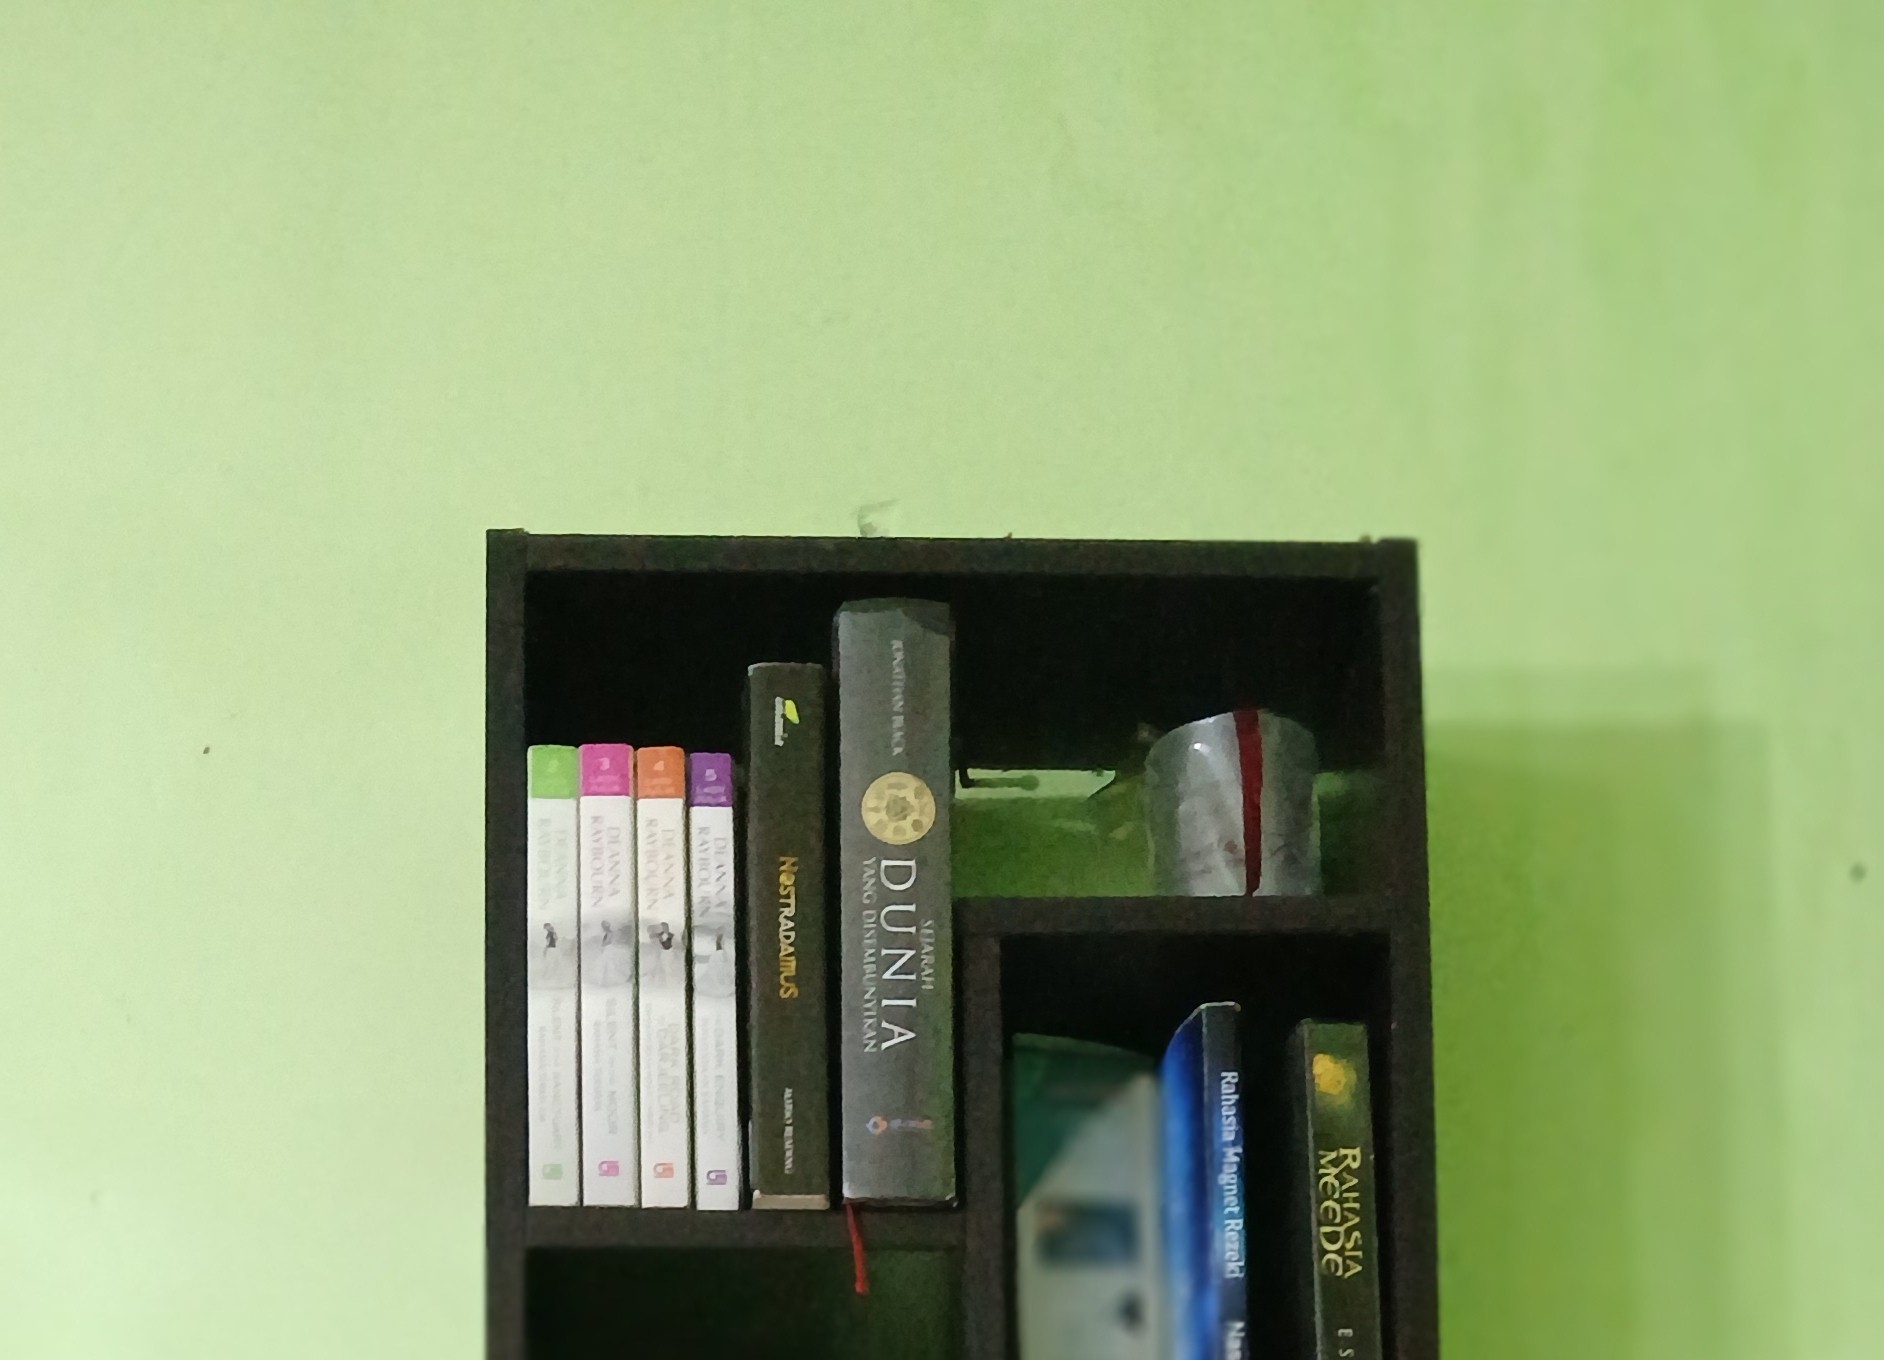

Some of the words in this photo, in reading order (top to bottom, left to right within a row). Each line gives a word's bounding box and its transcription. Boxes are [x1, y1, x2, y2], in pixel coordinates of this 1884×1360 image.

[590, 815, 605, 908] RAYBOURN
[607, 826, 621, 898] DEANNA
[644, 817, 659, 911] RAYBOURN
[661, 829, 676, 900] DEANNA
[697, 826, 712, 918] RAYBOURN
[714, 836, 729, 909] DEANNA
[861, 856, 878, 905] YANG
[861, 909, 878, 1054] DISEMBUNYIKAN
[879, 857, 917, 1052] DUNIA
[919, 918, 935, 990] SEJARAH
[1220, 1071, 1240, 1141] Rahasia
[1218, 1146, 1243, 1214] Magnet
[1318, 1149, 1344, 1278] MEEDE
[1338, 1146, 1363, 1279] RAHASIA
[1223, 1219, 1245, 1278] Rezeki
